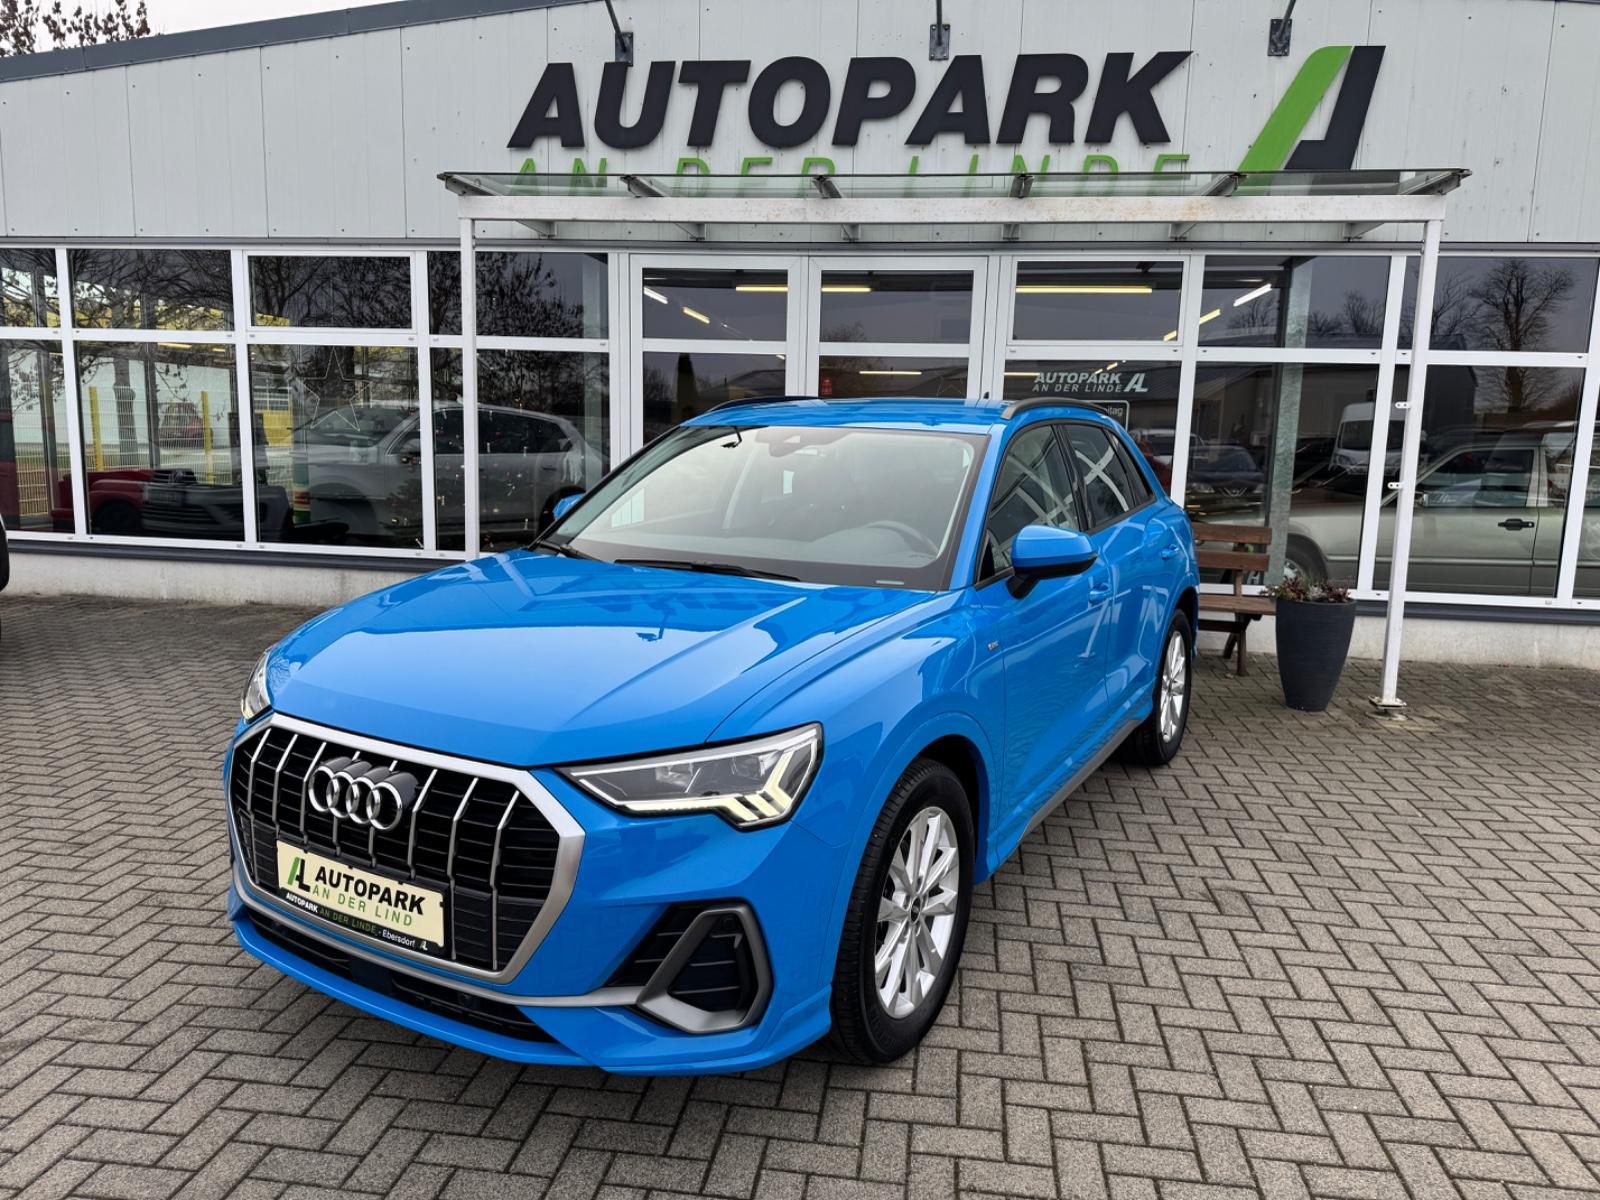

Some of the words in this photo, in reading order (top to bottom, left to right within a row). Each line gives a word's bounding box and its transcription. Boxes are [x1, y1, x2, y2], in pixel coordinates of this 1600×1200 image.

[508, 50, 1192, 150] AUTOPARK
[1032, 384, 1048, 392] AN
[1054, 384, 1079, 393] DER
[1085, 384, 1122, 393] LINDE
[1034, 372, 1122, 384] AUTOPARK
[312, 884, 331, 900] AN
[337, 893, 367, 913] DER
[375, 905, 413, 927] LIND
[315, 866, 426, 916] AUTOPARK
[286, 892, 319, 913] AUTOPARK
[319, 907, 330, 918] AN
[332, 912, 349, 924] DER
[382, 929, 416, 948] Ebersdorf
